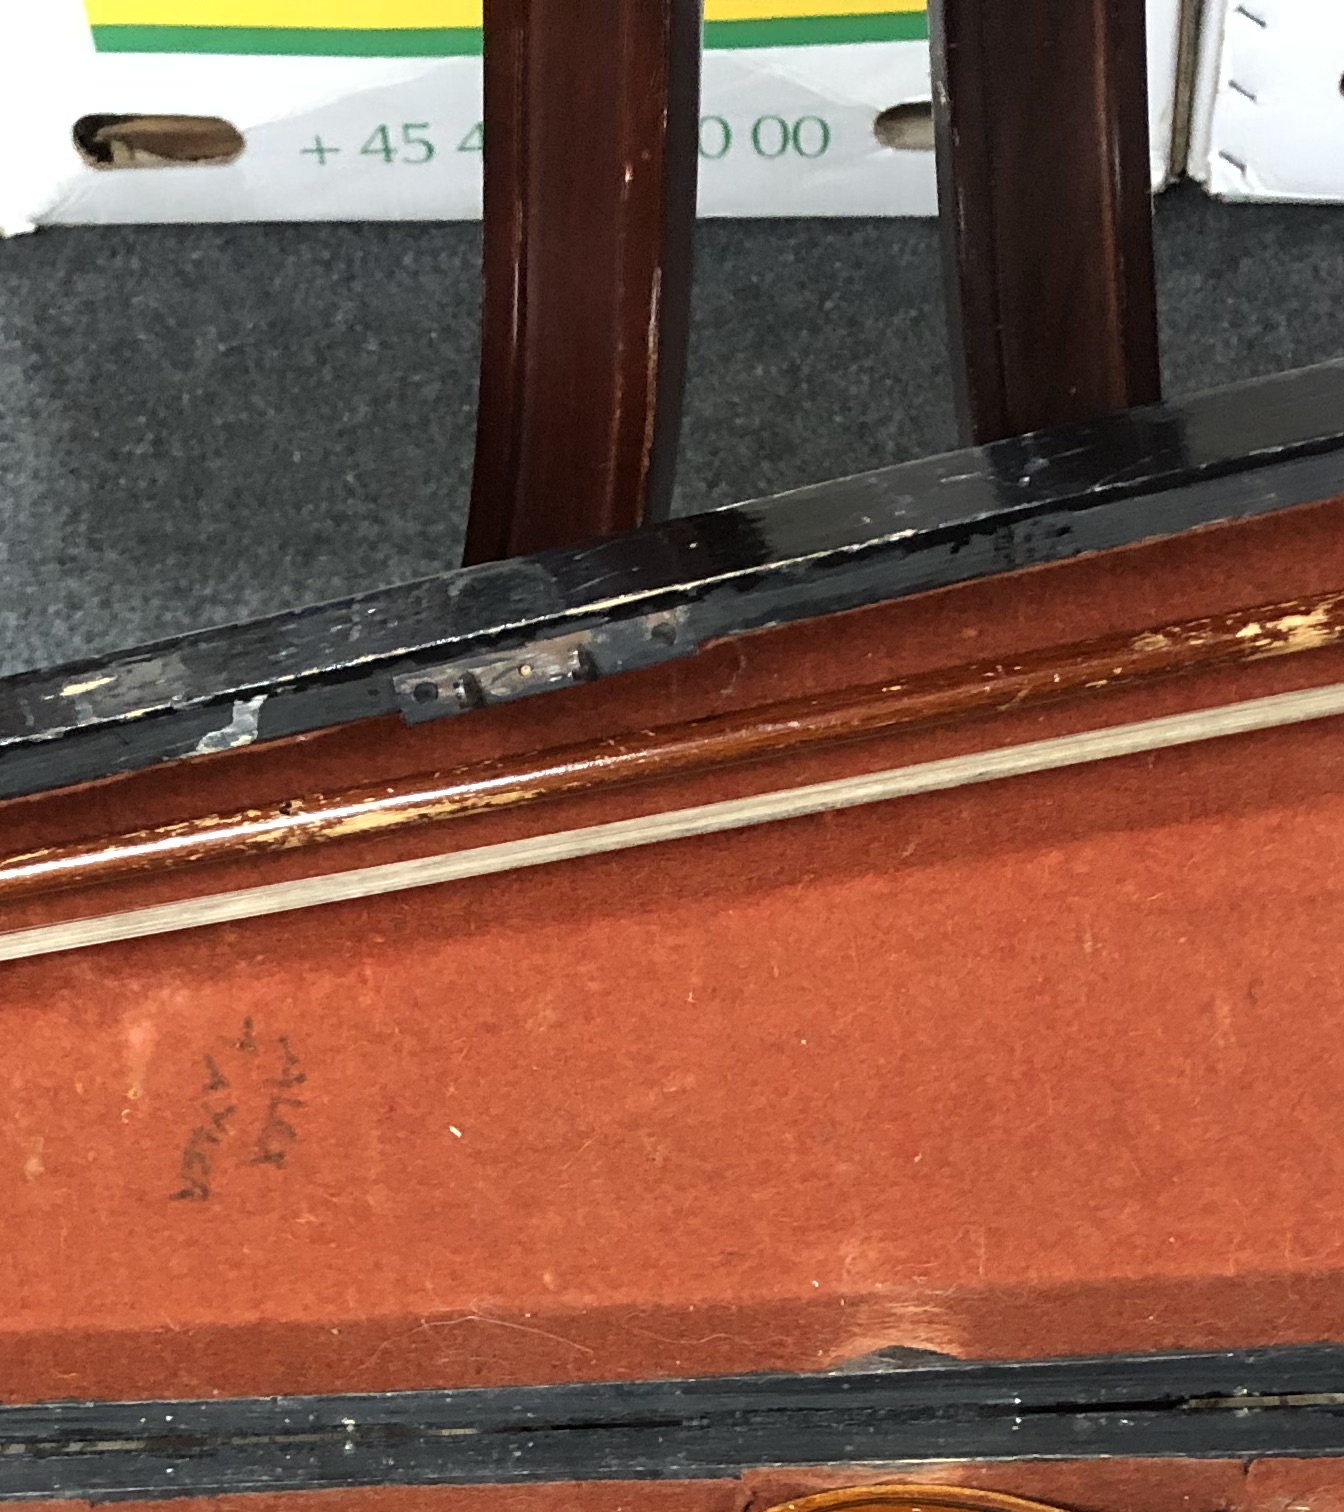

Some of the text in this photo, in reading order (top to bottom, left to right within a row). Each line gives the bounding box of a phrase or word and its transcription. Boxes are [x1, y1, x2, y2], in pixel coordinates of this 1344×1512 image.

[359, 121, 436, 165] 45
[456, 120, 485, 154] 4
[697, 114, 733, 159] 0
[752, 114, 832, 158] 00
